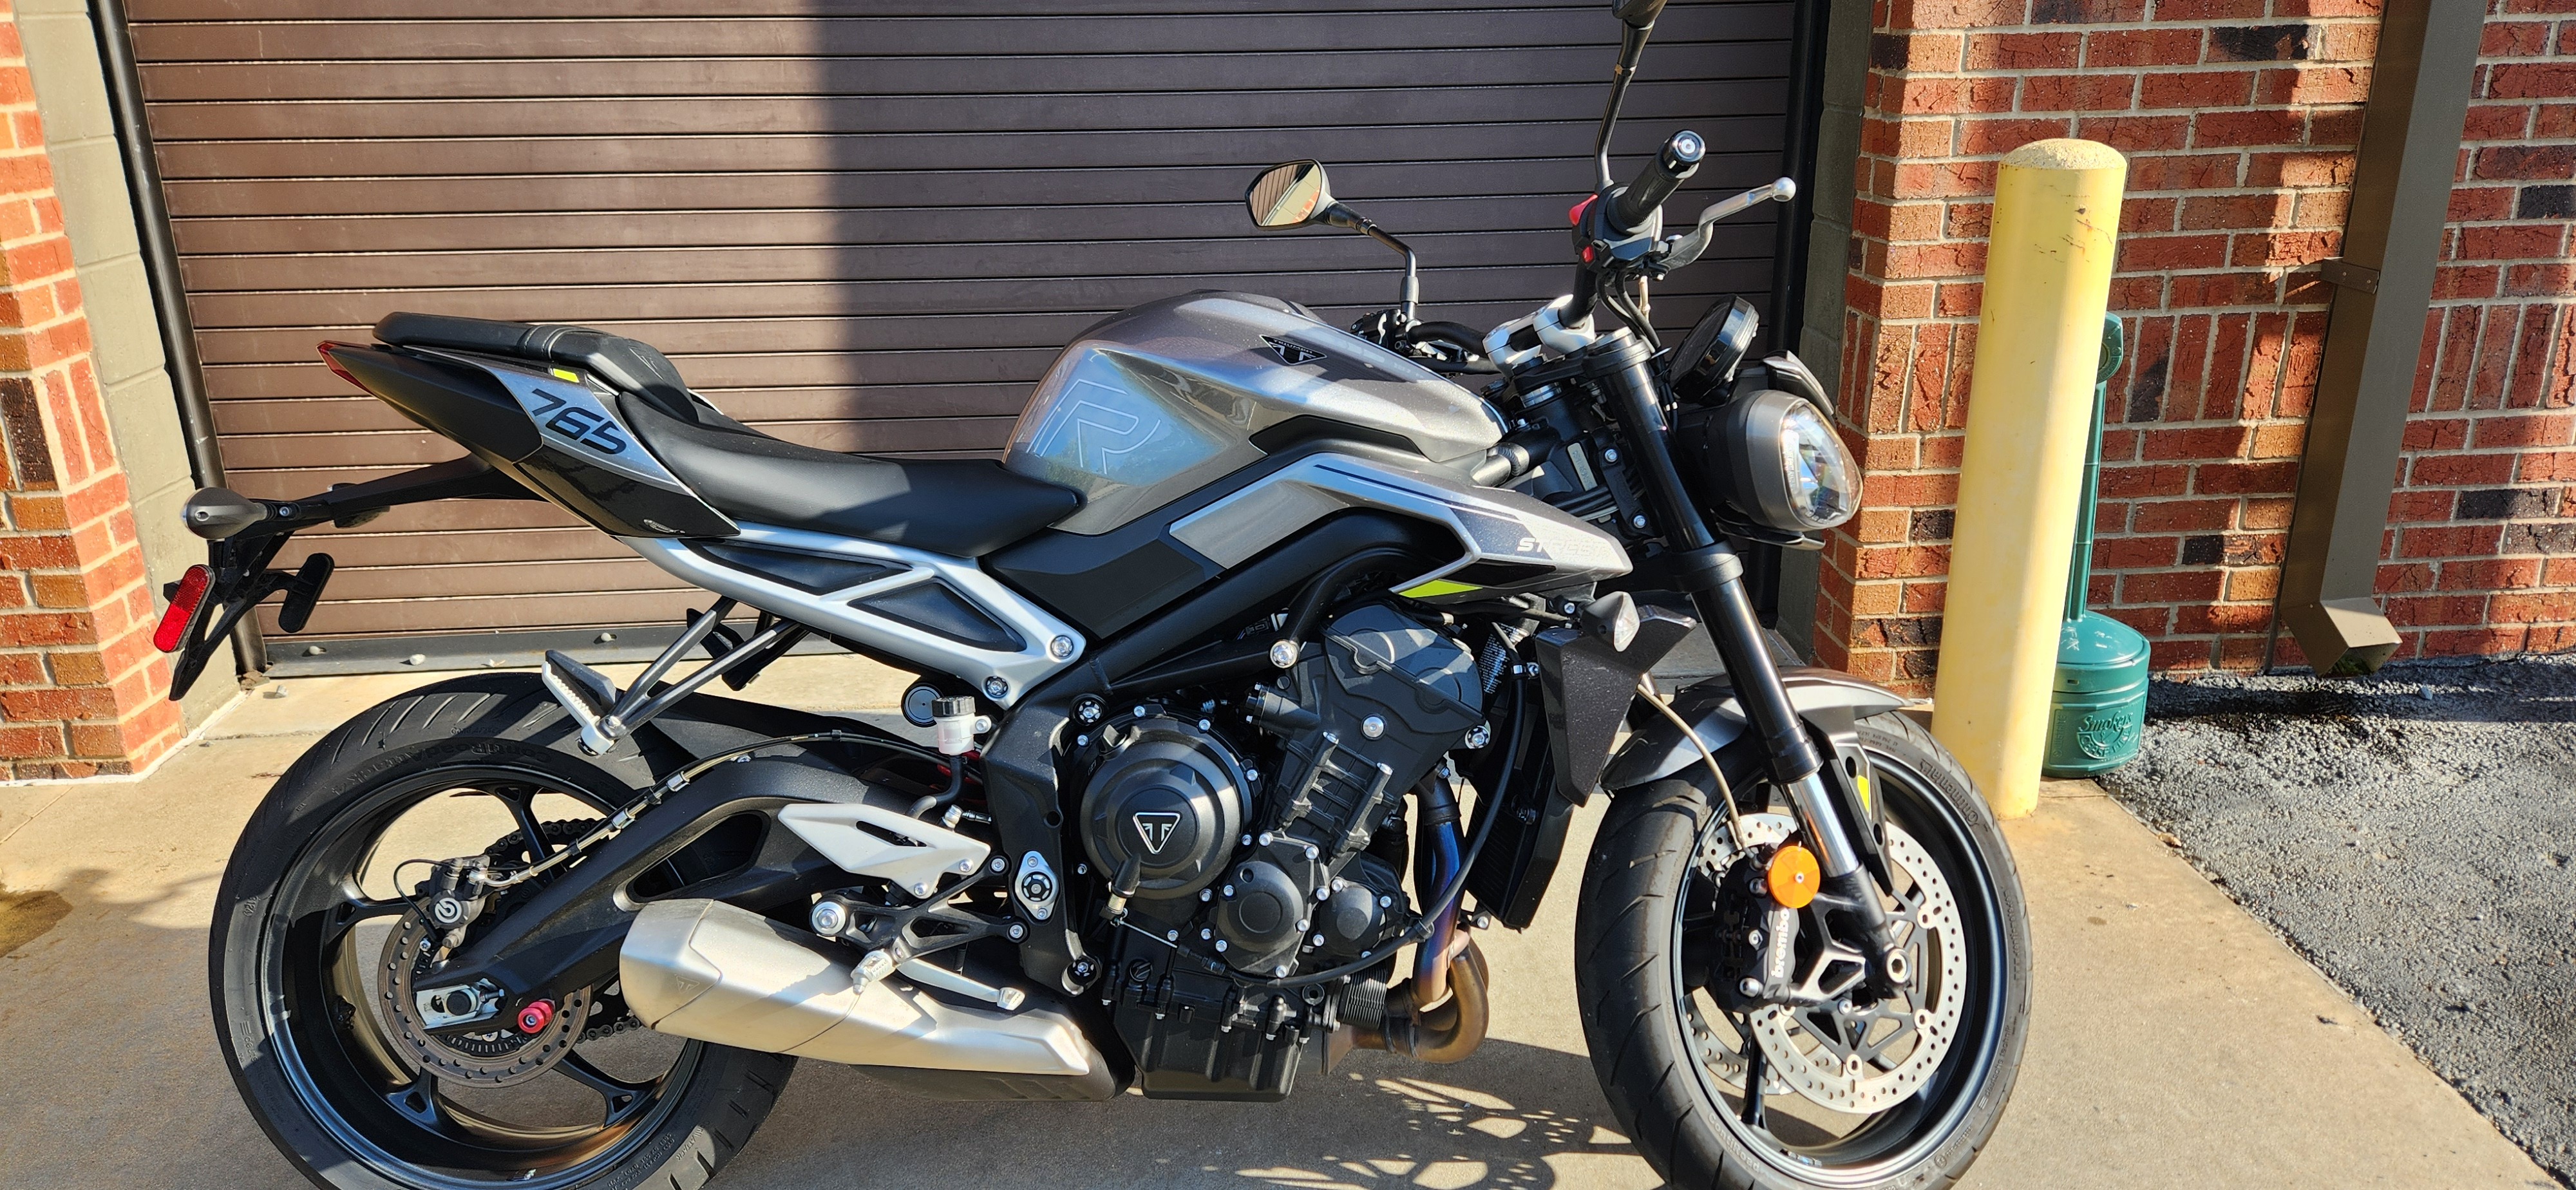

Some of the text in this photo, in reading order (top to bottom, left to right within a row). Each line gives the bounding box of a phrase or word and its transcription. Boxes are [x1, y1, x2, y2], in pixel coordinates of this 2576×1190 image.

[1273, 339, 1313, 354] TRIUMPH
[531, 388, 627, 455] 765
[1771, 907, 1790, 978] brembo
